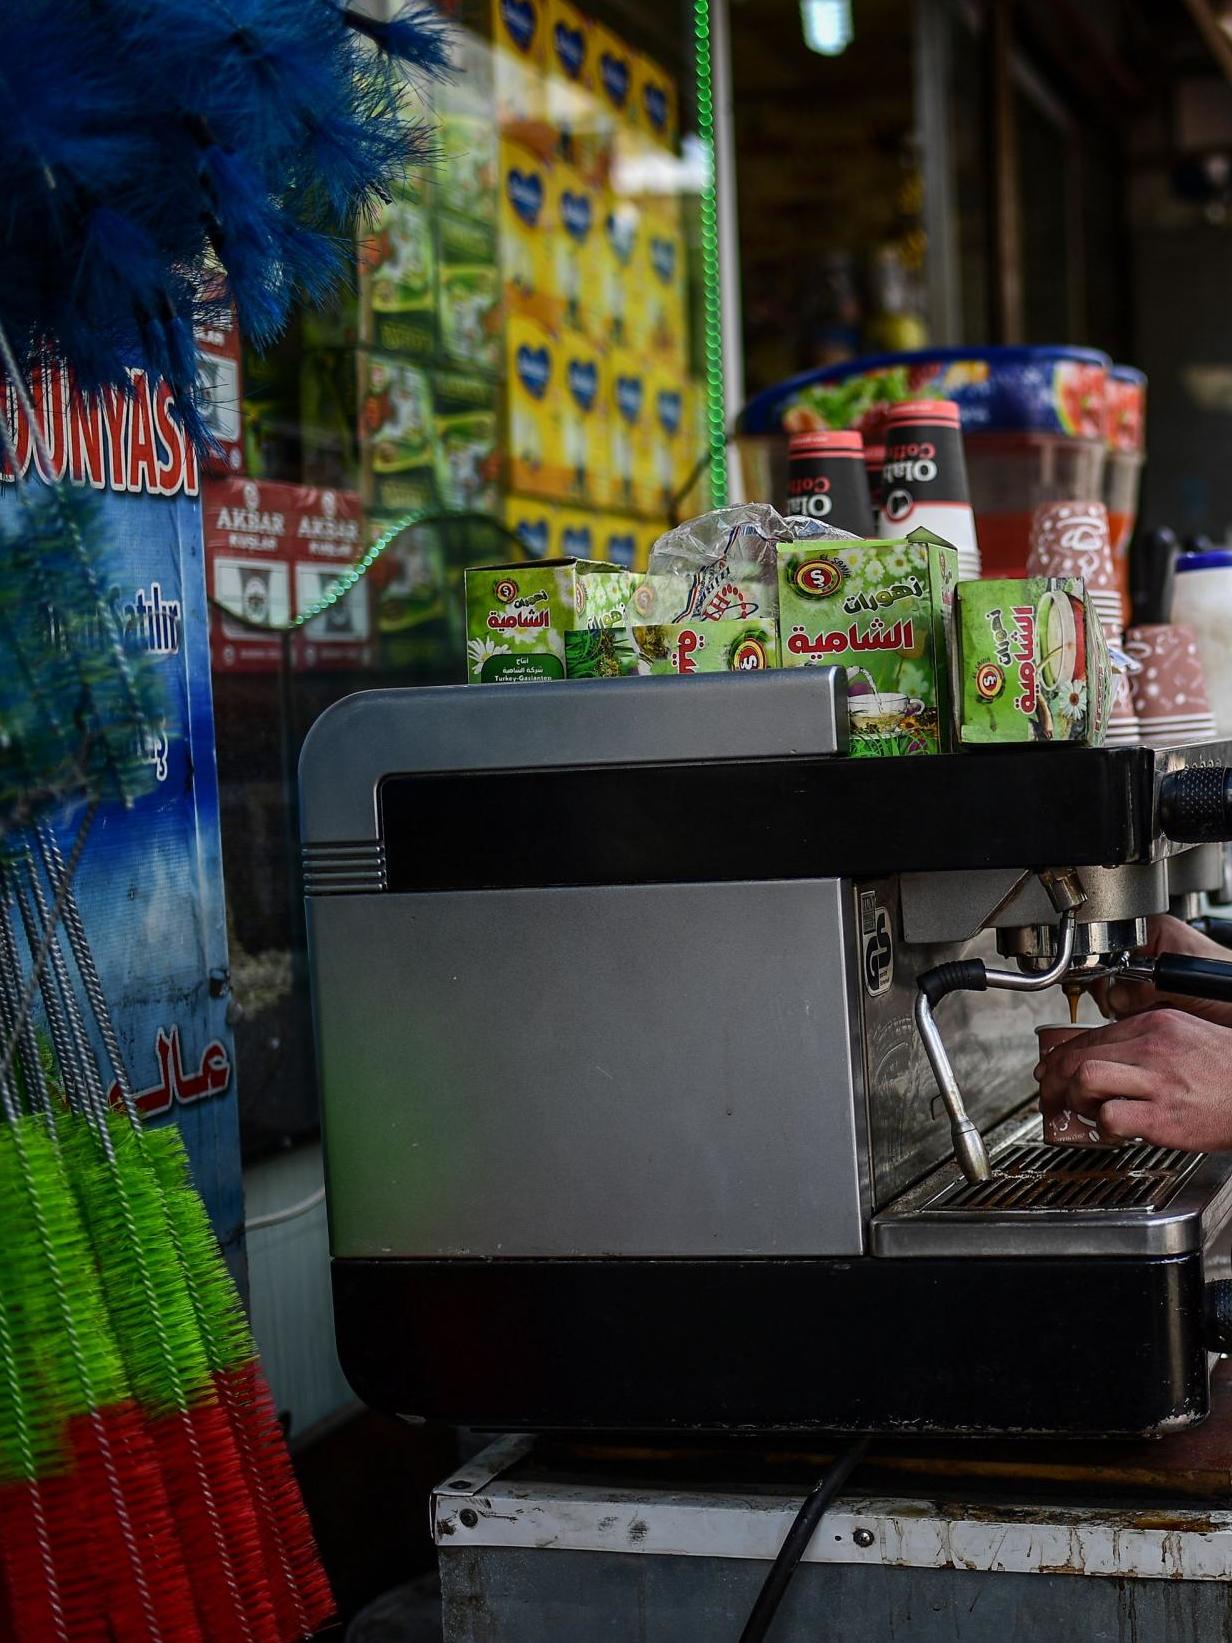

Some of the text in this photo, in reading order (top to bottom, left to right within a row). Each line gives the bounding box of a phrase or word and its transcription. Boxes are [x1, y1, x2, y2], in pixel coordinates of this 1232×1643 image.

[216, 507, 286, 537] AKBAR
[487, 609, 550, 632] الشامية
[787, 617, 915, 661] الشامية
[1010, 606, 1041, 715] الشامية
